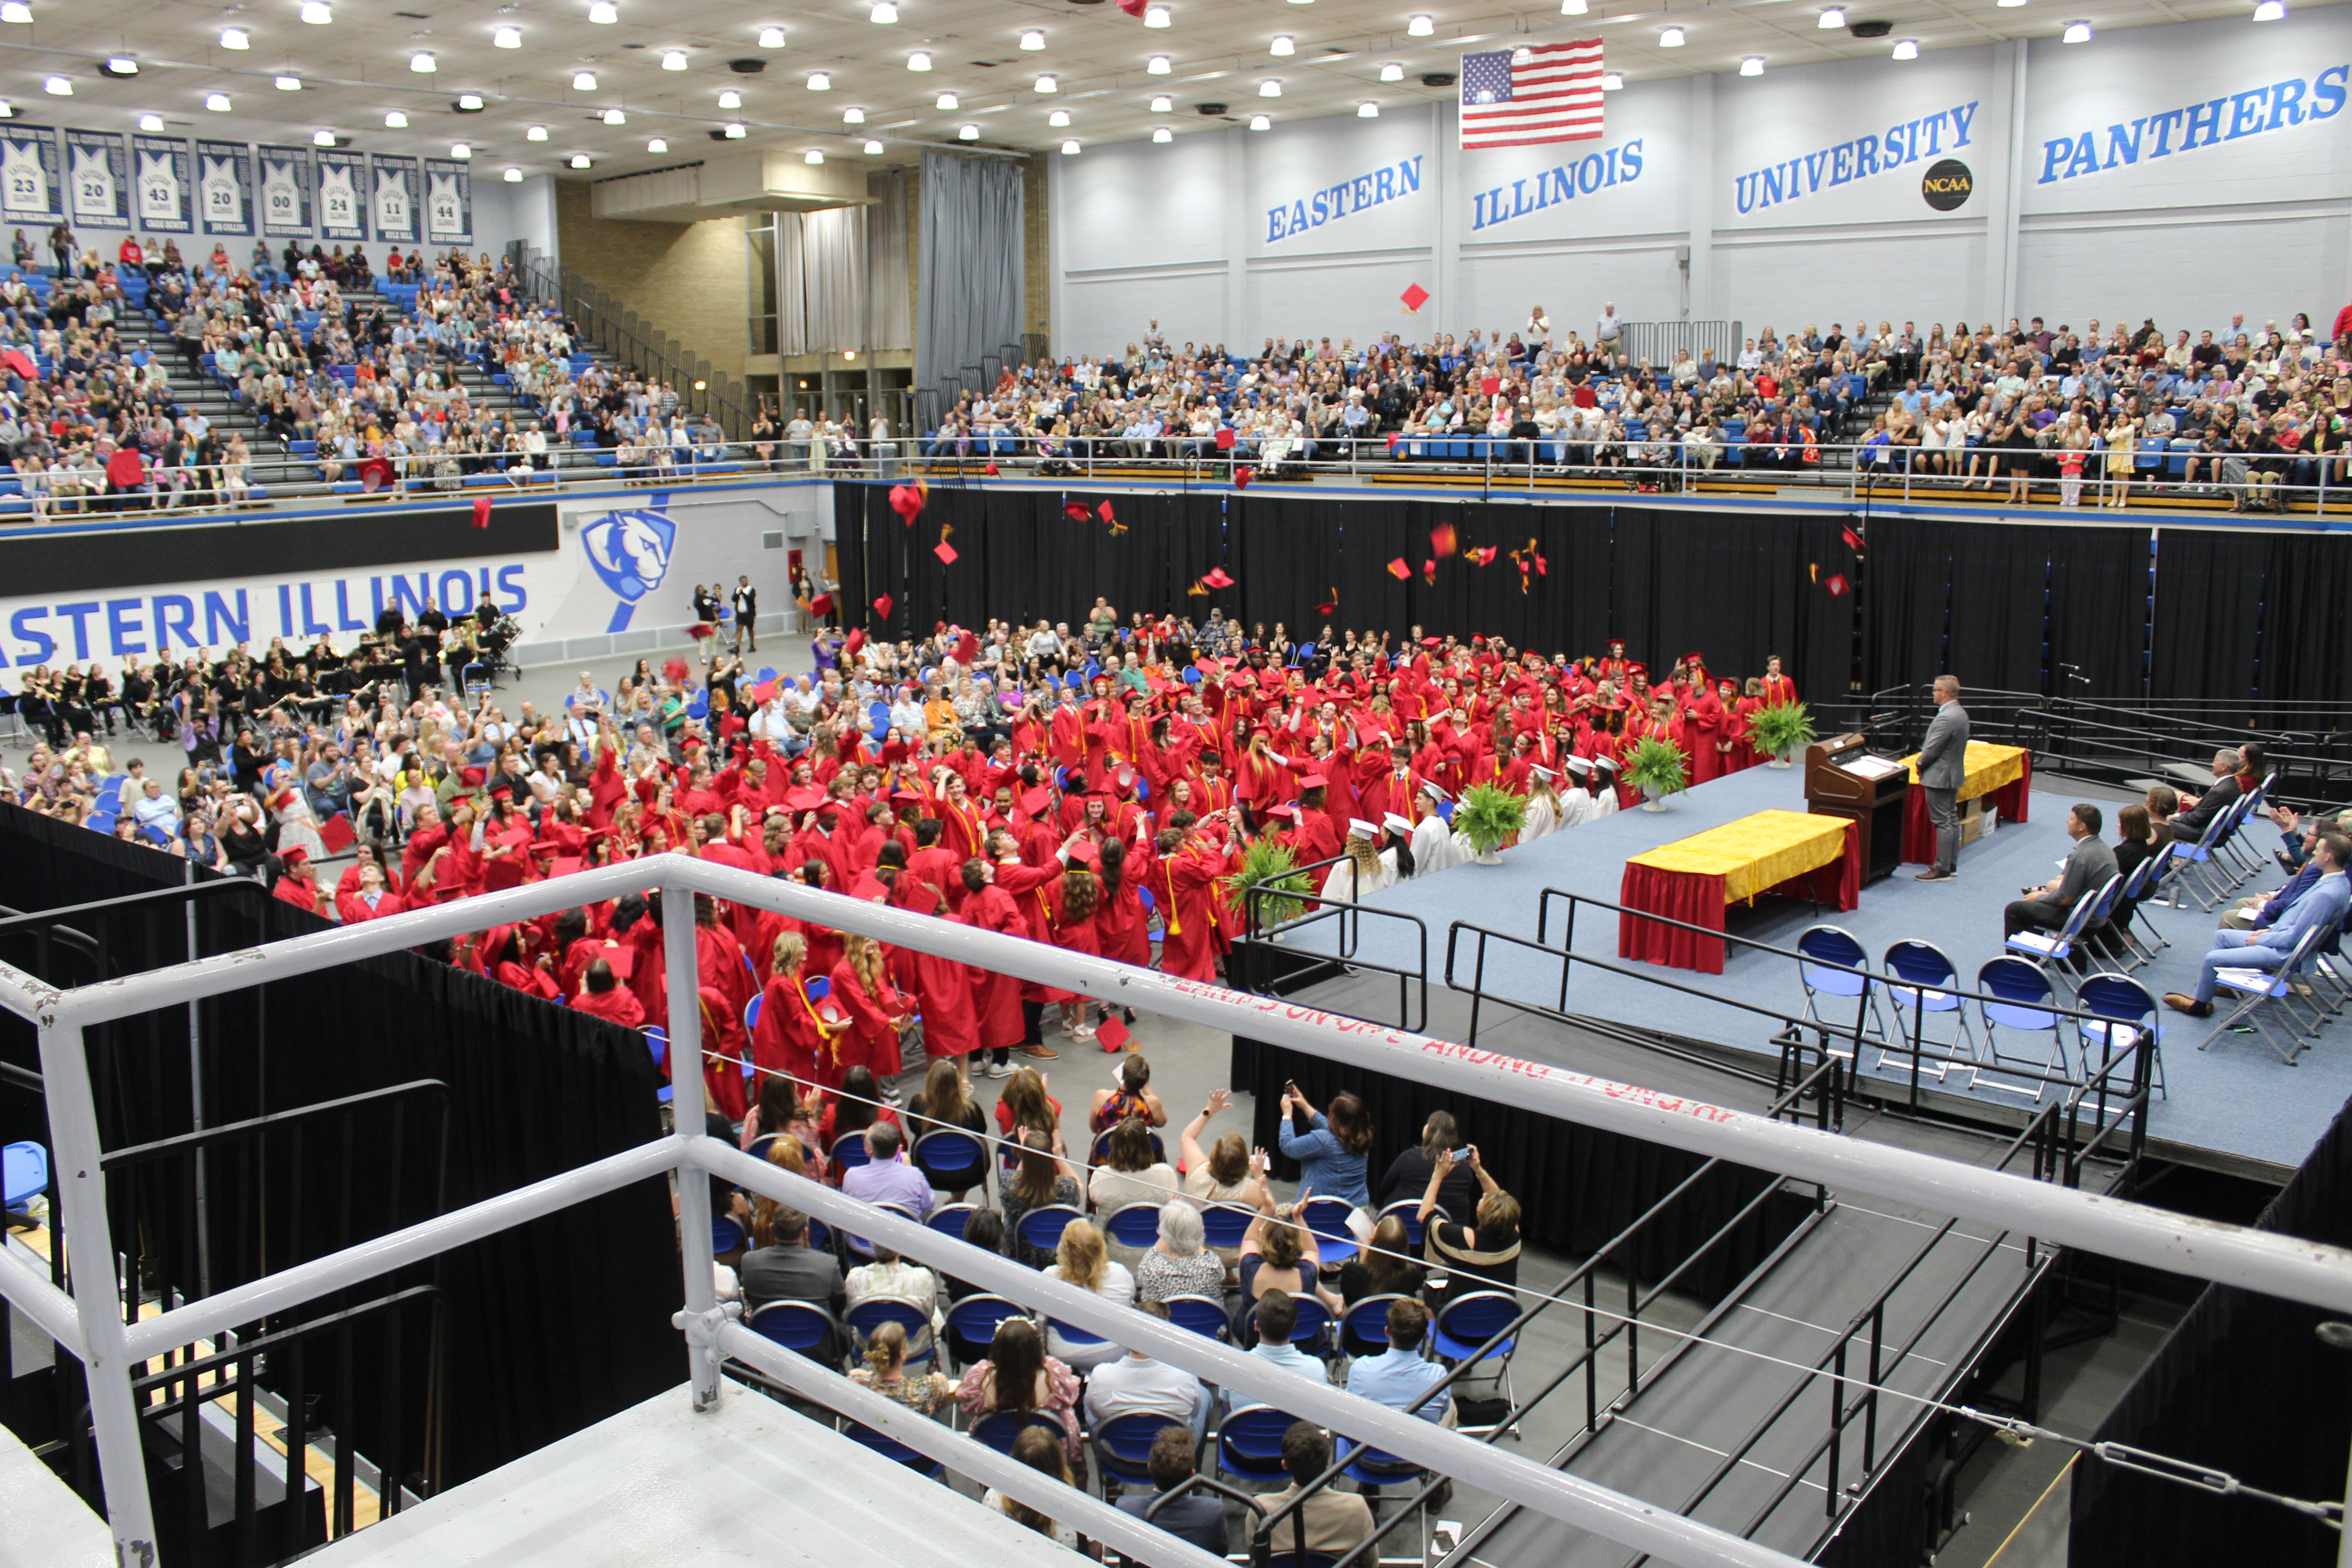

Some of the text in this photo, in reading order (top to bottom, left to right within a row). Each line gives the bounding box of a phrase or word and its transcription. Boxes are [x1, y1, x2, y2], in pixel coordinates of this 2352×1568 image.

[1265, 64, 2350, 244] EASTERN ILLINOIS UNIVERSITY PANTHERS
[13, 178, 34, 192] 23
[83, 183, 103, 196] 20
[1924, 176, 1970, 193] NCAA
[148, 187, 168, 201] 43
[326, 186, 349, 196] EASTERN
[381, 189, 402, 200] EASTERN
[211, 192, 230, 204] 20
[273, 196, 290, 207] 00
[433, 193, 456, 203] EASTERN
[329, 198, 347, 211] 24
[385, 202, 400, 214] 11
[436, 206, 453, 218] 44
[211, 222, 248, 233] JON COLLINS
[329, 227, 362, 237] JAY TAYLOR
[385, 231, 399, 239] KYLE
[277, 564, 527, 638] ILLINOIS
